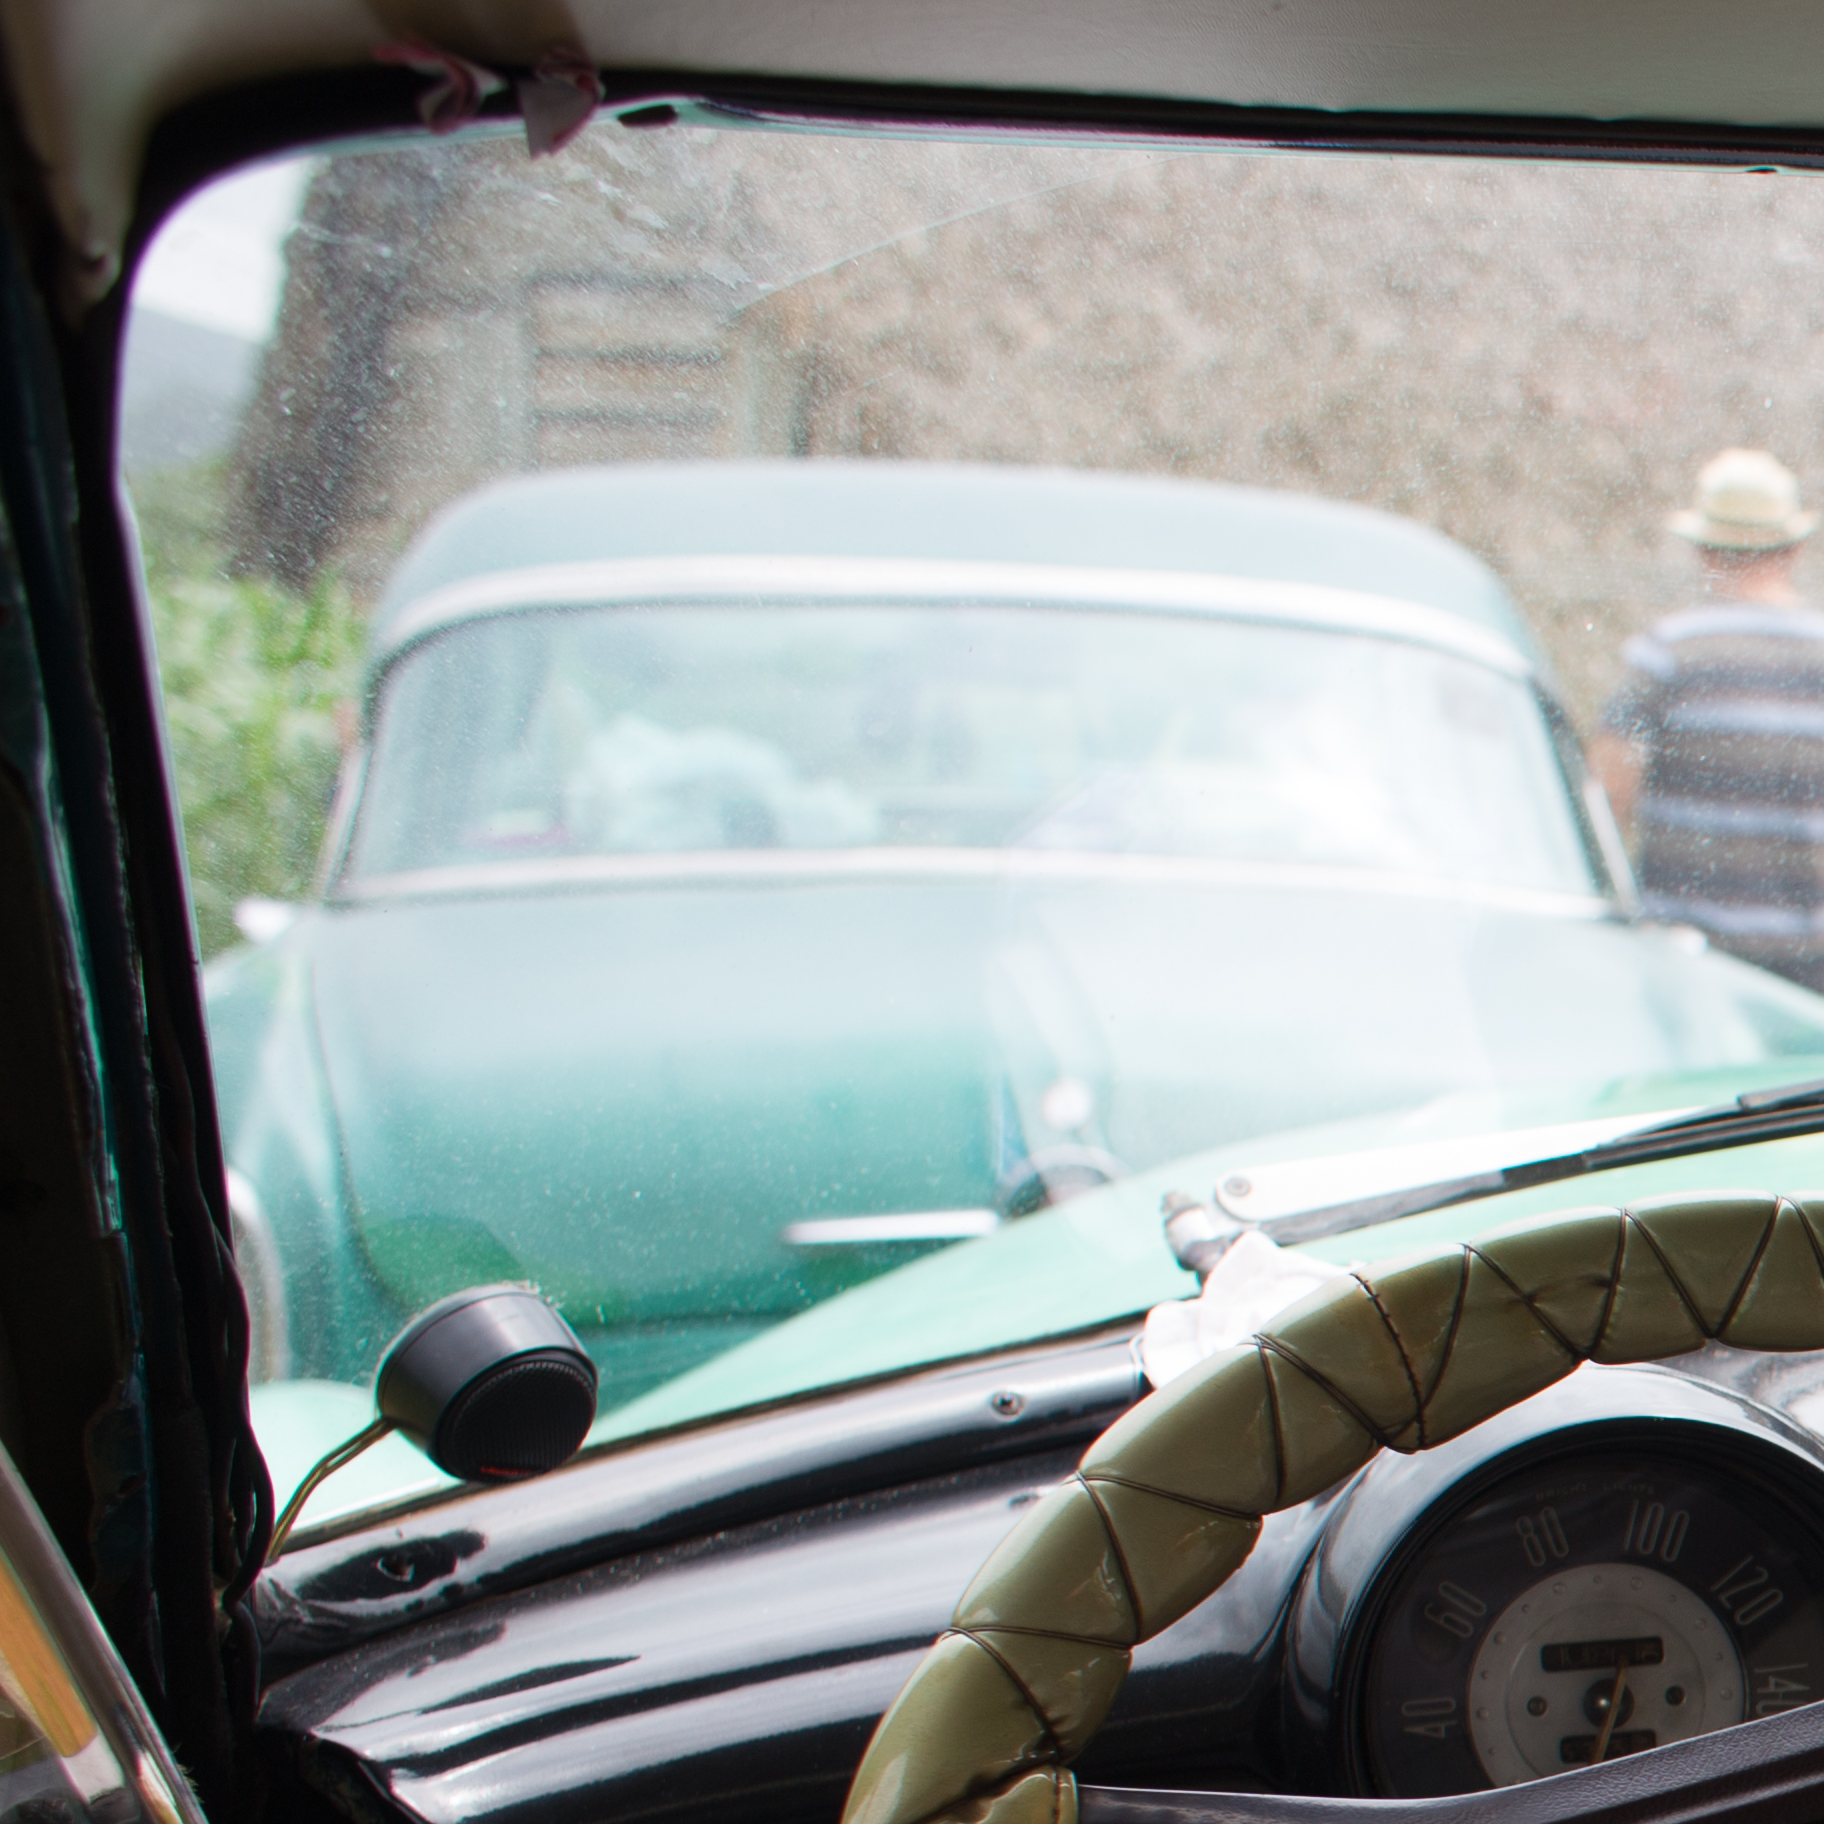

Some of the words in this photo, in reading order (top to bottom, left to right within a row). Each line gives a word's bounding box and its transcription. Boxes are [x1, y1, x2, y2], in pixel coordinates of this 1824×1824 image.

[1515, 1506, 1569, 1566] 80
[1622, 1499, 1690, 1563] 100
[1424, 1581, 1488, 1638] 60
[1709, 1554, 1785, 1626] 120
[1401, 1696, 1457, 1740] 40
